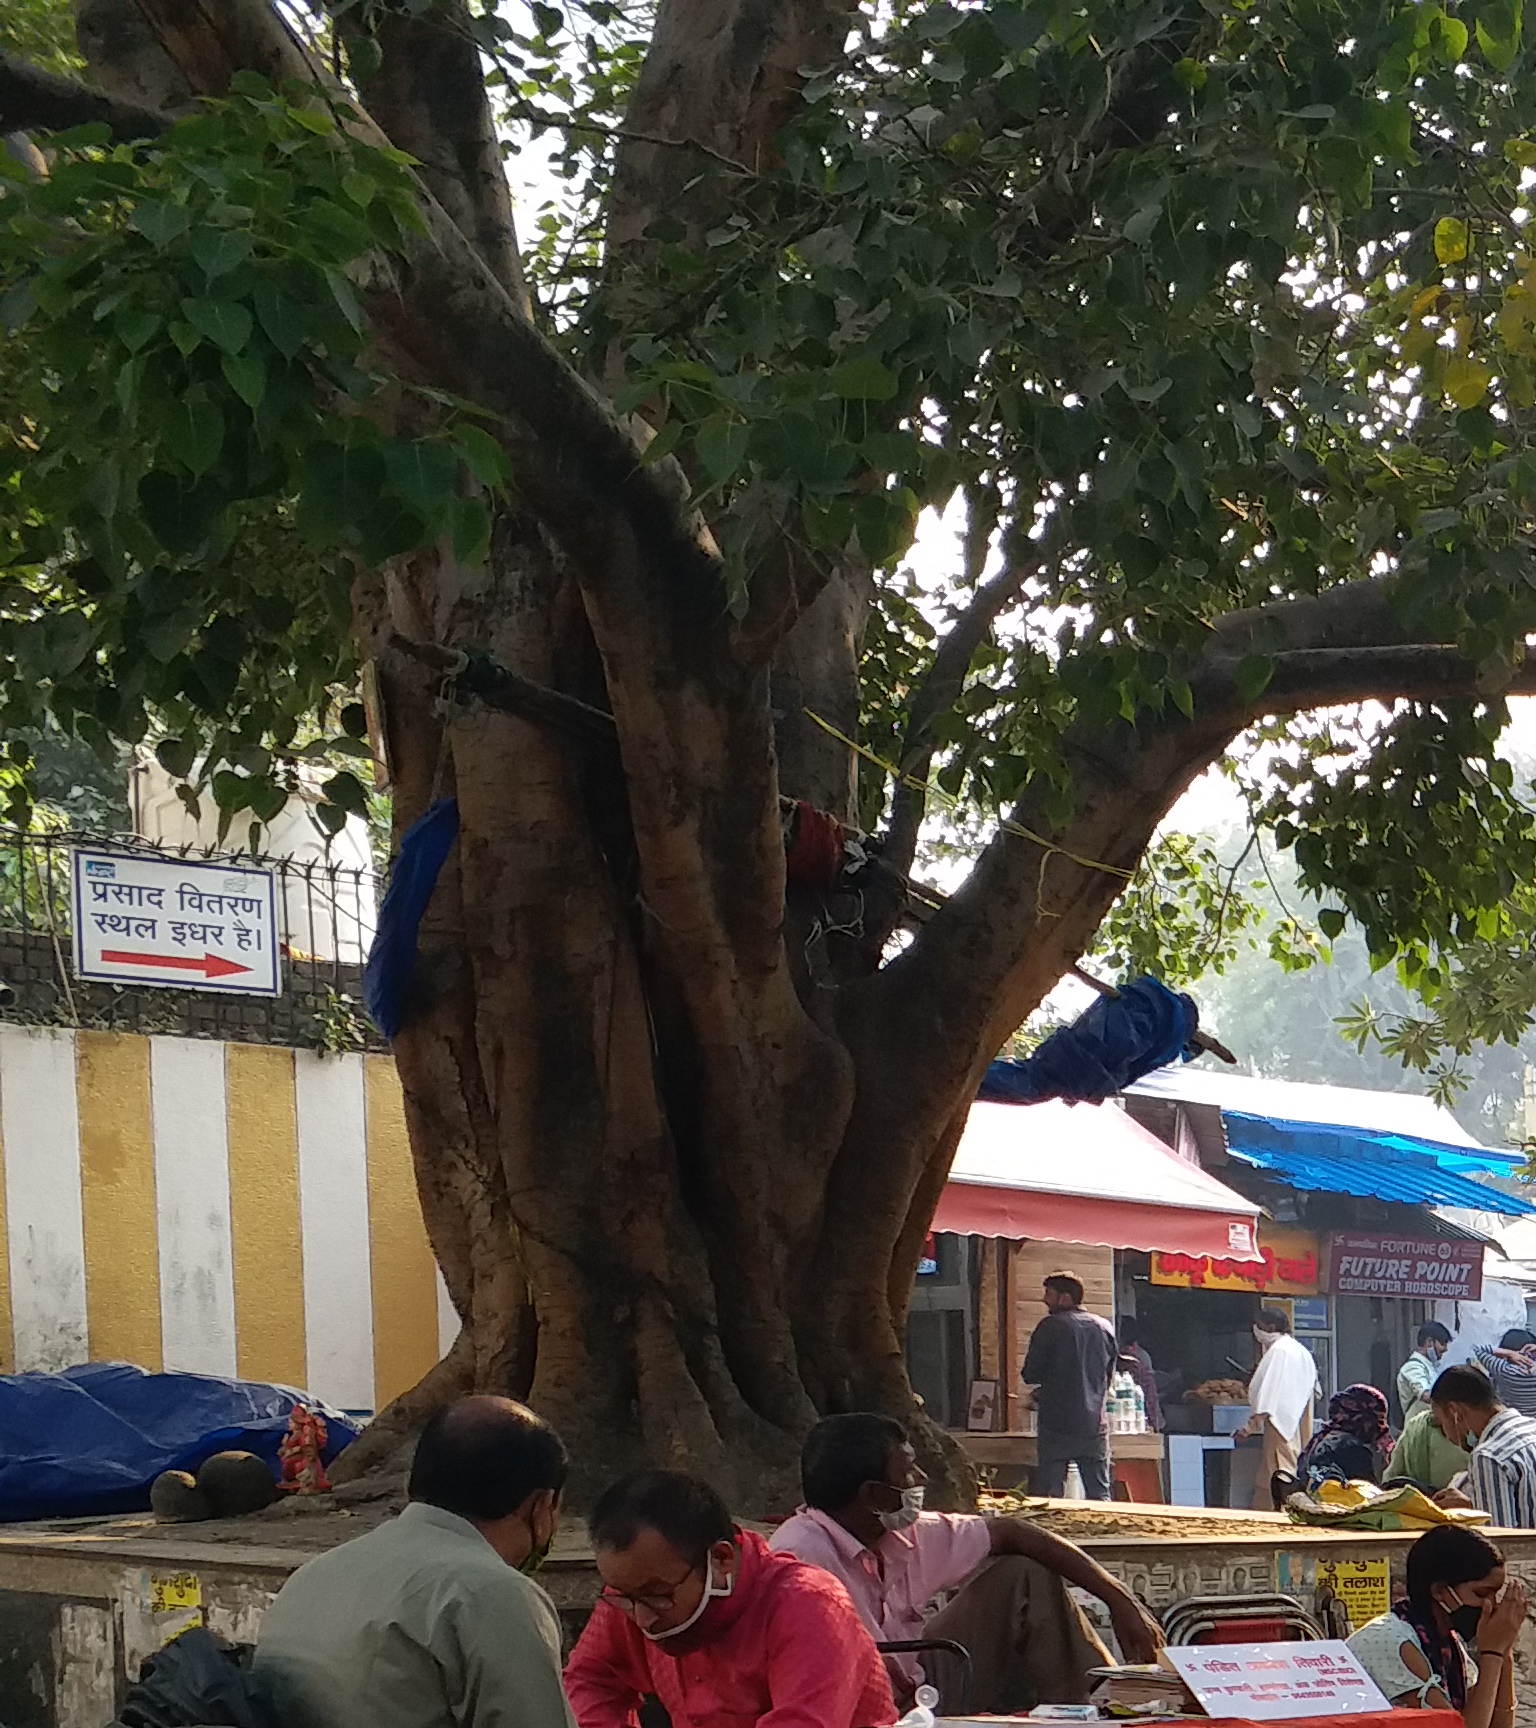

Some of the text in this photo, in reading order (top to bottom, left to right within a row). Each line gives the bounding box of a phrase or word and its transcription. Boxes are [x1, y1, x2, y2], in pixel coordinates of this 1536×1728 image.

[88, 880, 166, 910] प्रसाद
[175, 882, 263, 920] वितरण
[90, 912, 262, 951] स्थल इधर है।
[1380, 1240, 1437, 1256] FORTUNE
[1339, 1256, 1472, 1283] FUTURE POINT
[1338, 1277, 1470, 1297] COMPUTER HOROSCOPE
[1343, 1576, 1386, 1589] तलाश
[1203, 1659, 1241, 1673] पंडित
